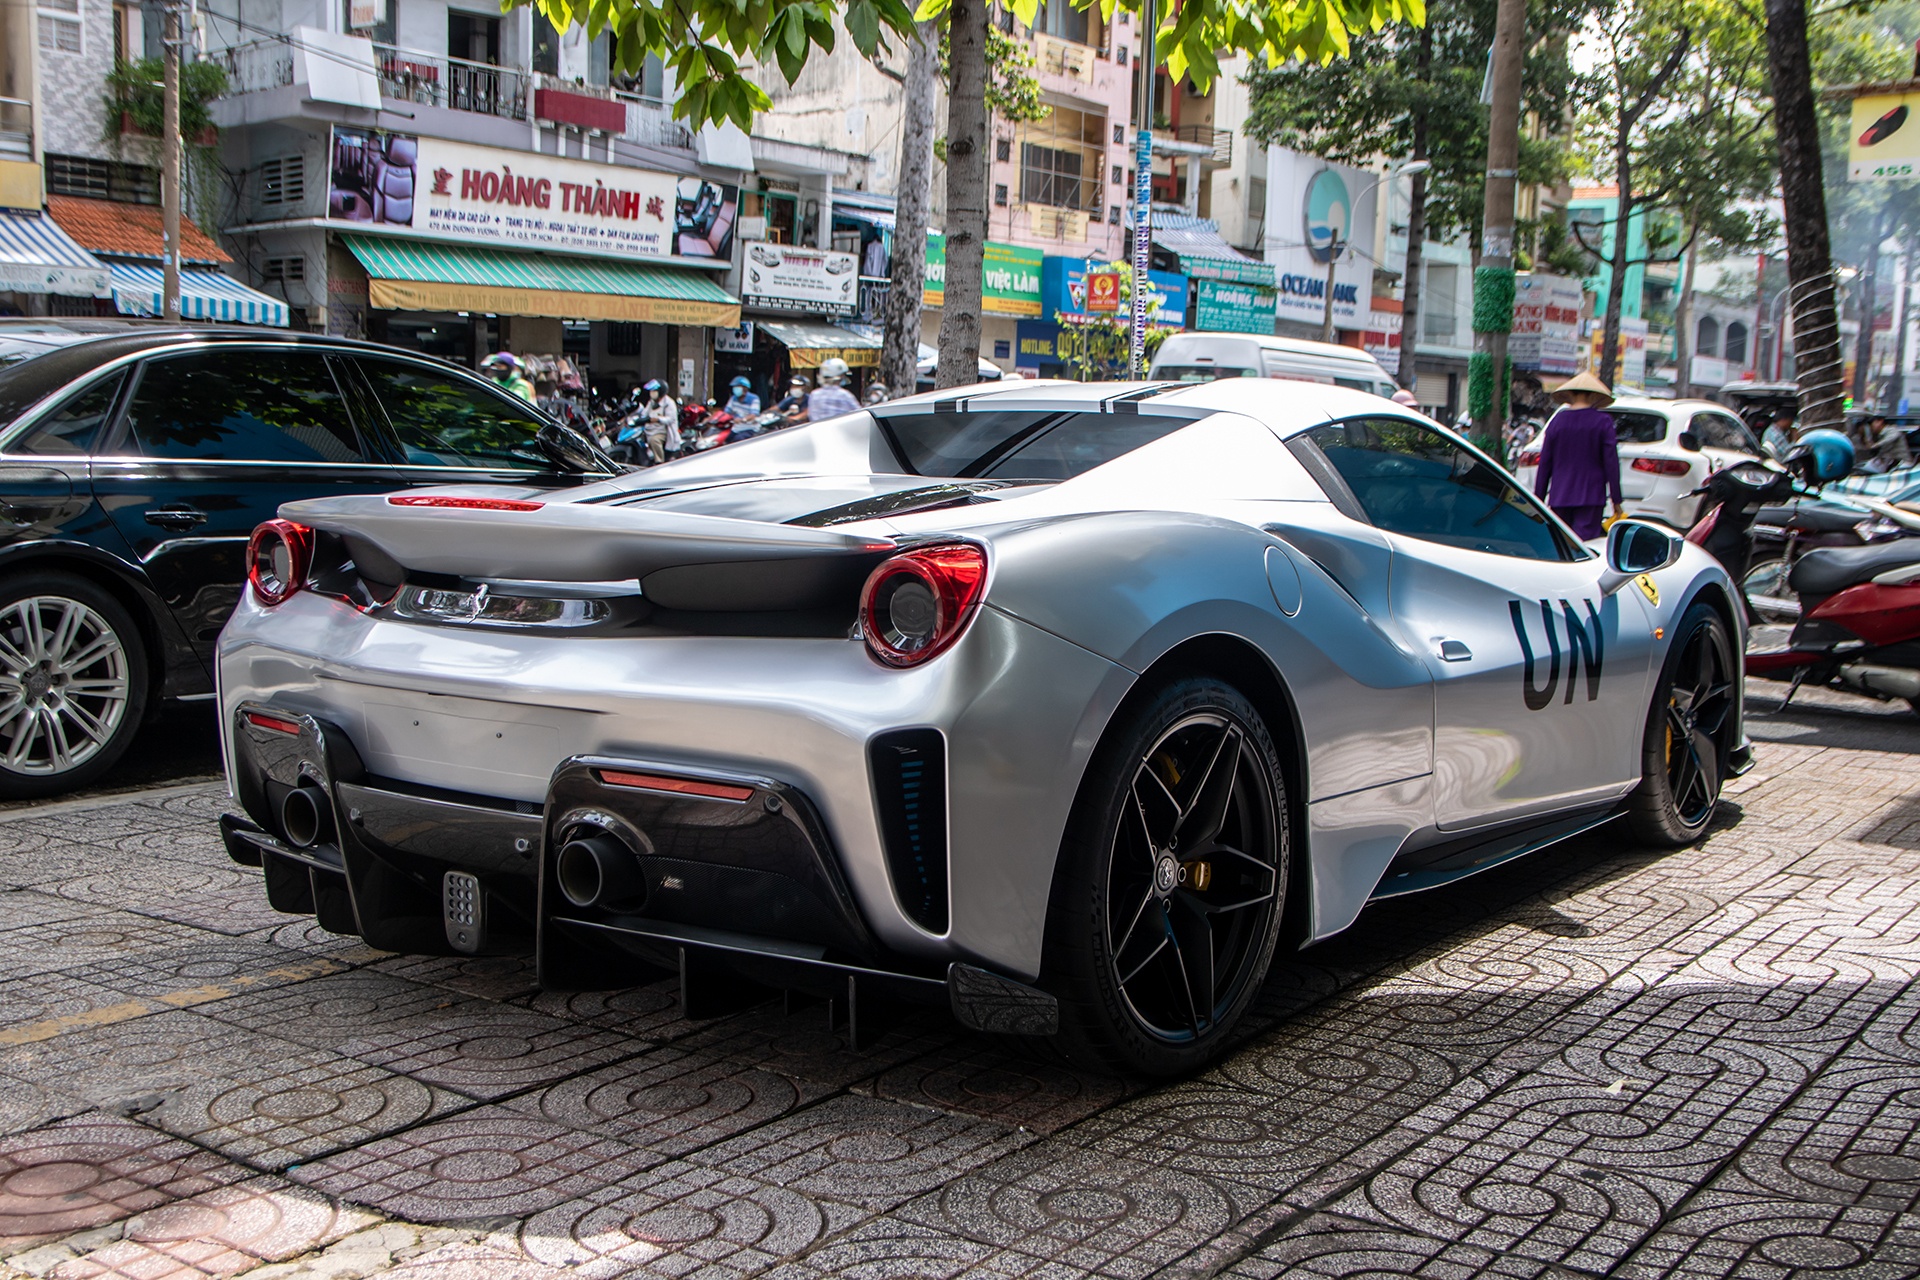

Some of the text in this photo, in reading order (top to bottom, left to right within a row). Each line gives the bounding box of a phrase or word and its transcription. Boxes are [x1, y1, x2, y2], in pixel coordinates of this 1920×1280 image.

[1871, 164, 1912, 176] 455
[461, 164, 641, 220] HOÀNG THÀNH
[442, 223, 452, 232] AN
[985, 267, 1012, 294] VIỆC
[1013, 270, 1040, 294] LÀM
[1281, 273, 1324, 298] OCEAN
[1325, 281, 1359, 305] ANK
[1215, 287, 1253, 307] HOÀNG
[1021, 338, 1054, 356] HOTLINE:
[1507, 598, 1604, 711] UN
[1268, 749, 1290, 829] MICHELIN
